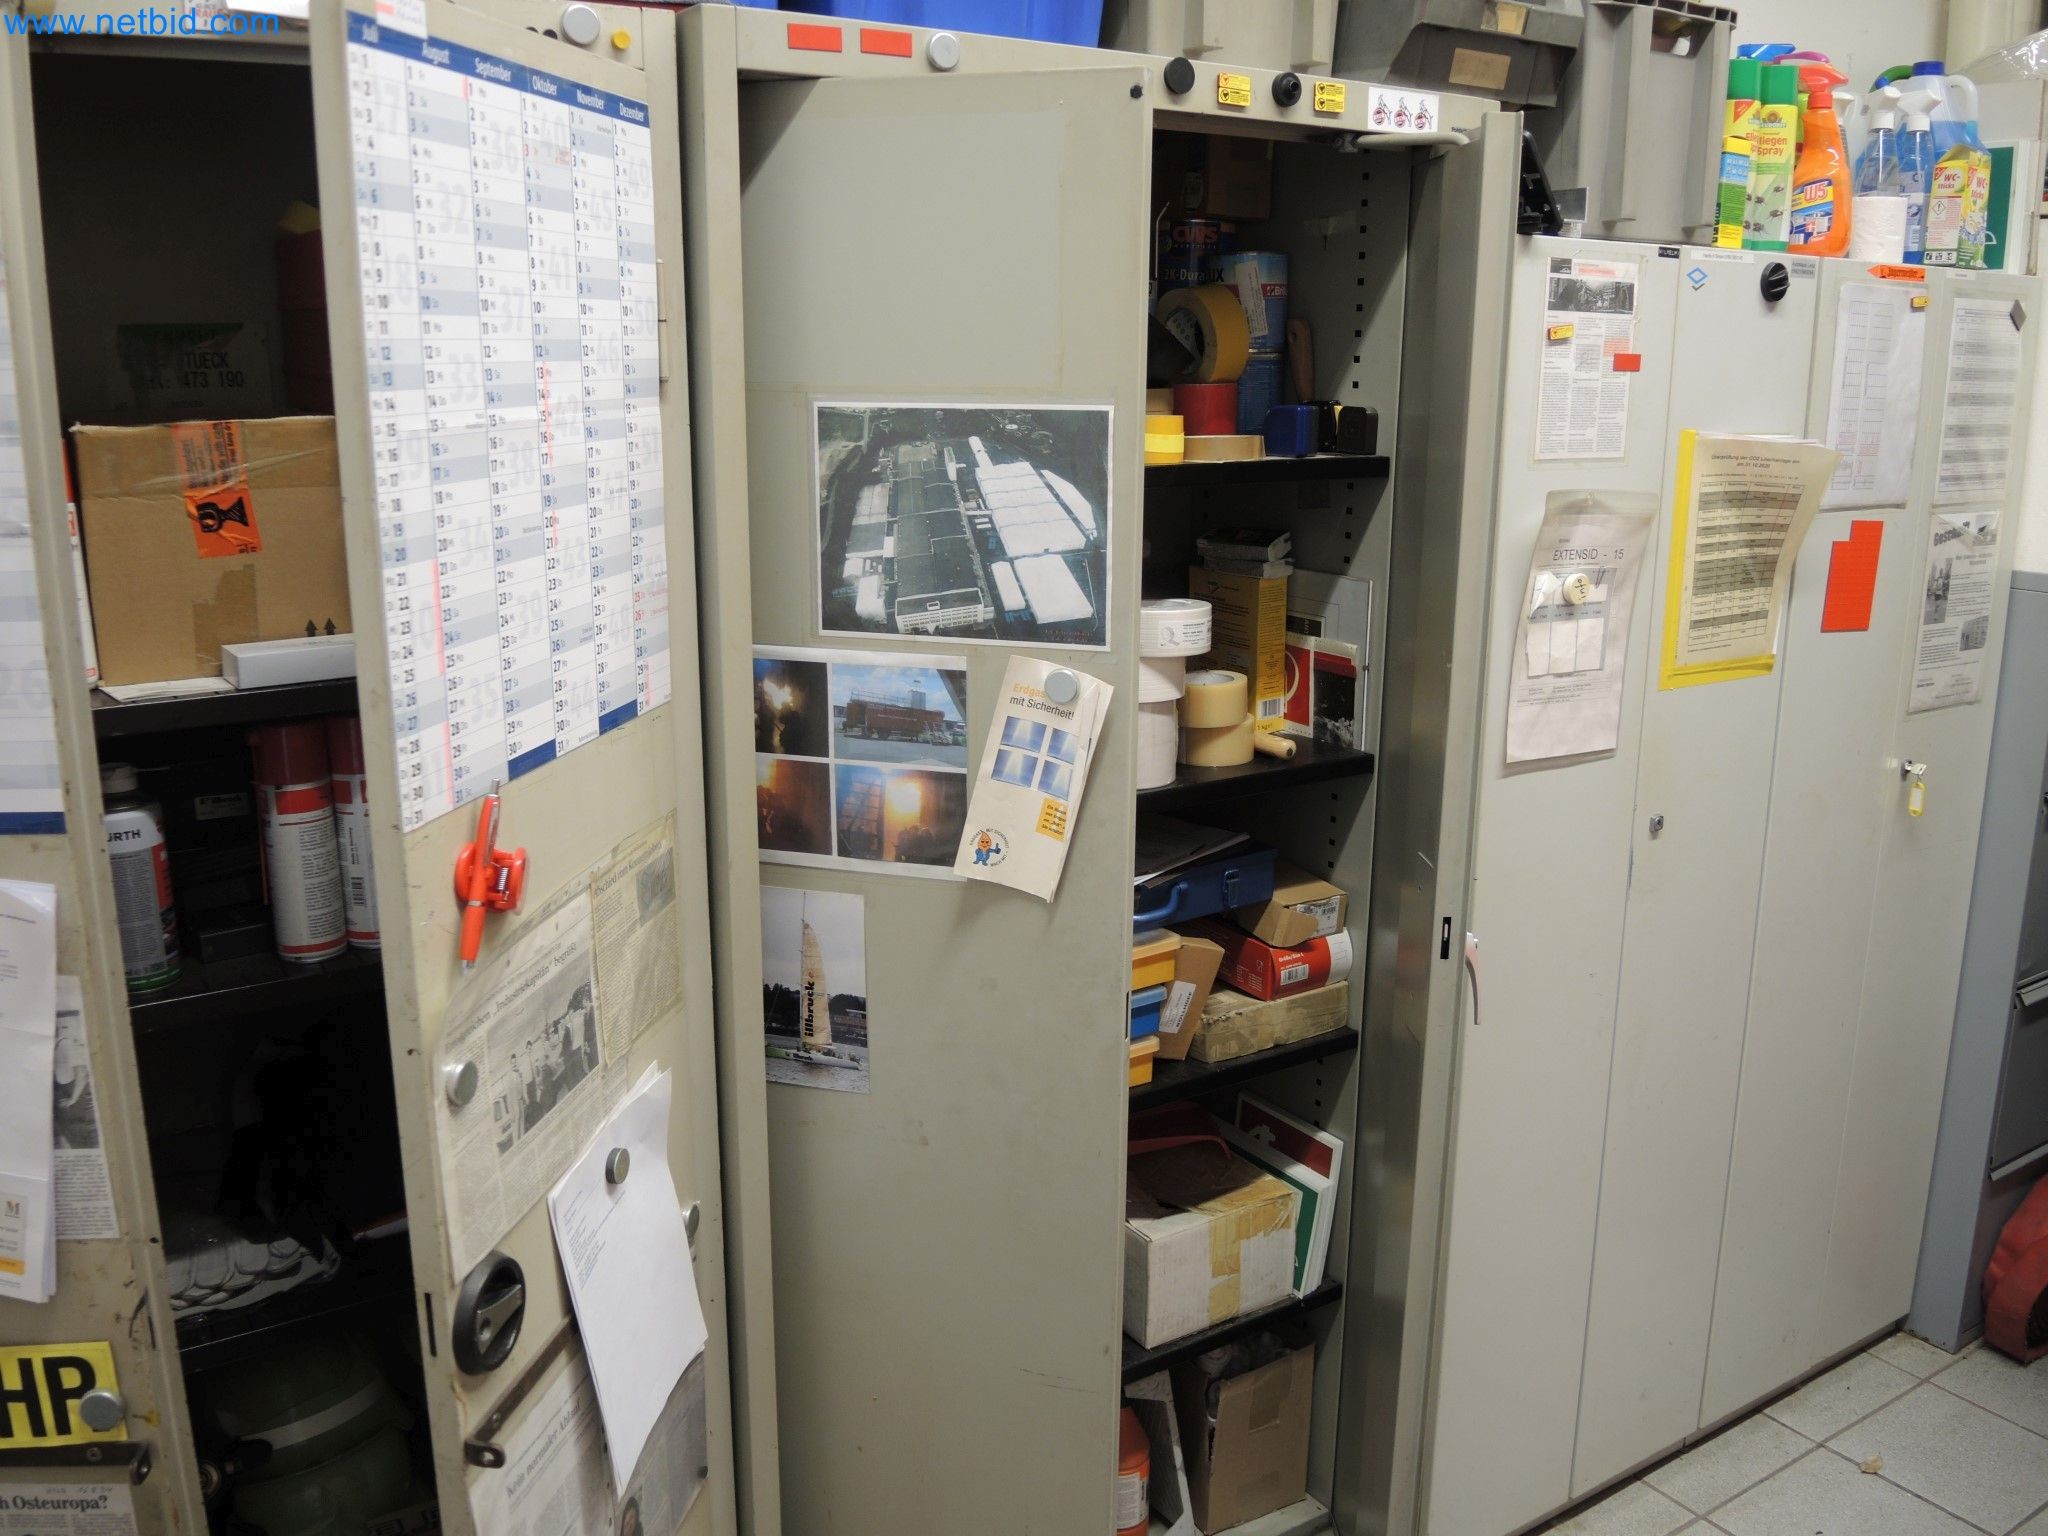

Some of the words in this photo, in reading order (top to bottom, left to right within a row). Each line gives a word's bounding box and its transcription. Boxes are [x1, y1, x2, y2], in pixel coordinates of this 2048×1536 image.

[422, 42, 450, 65] August
[475, 57, 512, 83] September
[532, 75, 558, 97] Oktober
[576, 88, 605, 111] November
[619, 102, 645, 123] Dezember
[1944, 173, 1961, 182] WC-
[480, 298, 489, 311] 10
[533, 301, 541, 313] 10
[481, 322, 490, 334] 11
[533, 323, 542, 335] 11
[483, 345, 492, 358] 12
[534, 345, 543, 357] 12
[484, 368, 493, 381] 13
[536, 366, 545, 378] 13
[218, 370, 245, 388] 190
[486, 391, 495, 404] 14
[537, 388, 546, 400] 14
[488, 414, 497, 427] 15
[538, 410, 546, 422] 15
[489, 436, 498, 449] 16
[540, 431, 548, 443] 16
[540, 452, 549, 464] 17
[490, 459, 499, 472] 17
[542, 474, 551, 486] 18
[491, 481, 500, 494] 18
[543, 495, 552, 507] 19
[493, 504, 502, 517] 19
[544, 516, 553, 528] 20
[494, 526, 504, 539] 20
[545, 537, 554, 549] 21
[495, 548, 504, 561] 21
[1552, 548, 1599, 561] EXTENSID
[1613, 549, 1625, 560] 15
[547, 558, 556, 570] 22
[497, 570, 506, 583] 22
[548, 578, 557, 590] 23
[498, 592, 507, 605] 23
[549, 599, 558, 611] 24
[500, 614, 509, 627] 24
[550, 619, 559, 631] 25
[501, 636, 510, 648] 25
[552, 640, 560, 652] 26
[502, 657, 512, 670] 26
[552, 660, 561, 672] 27
[503, 678, 512, 691] 27
[554, 680, 563, 692] 28
[505, 700, 514, 712] 28
[555, 700, 564, 712] 29
[1009, 696, 1025, 707] mit
[1027, 698, 1075, 720] Sicherheit!
[506, 721, 516, 734] 29
[556, 719, 565, 731] 30
[508, 742, 517, 755] 30
[557, 740, 566, 752] 31
[804, 981, 815, 1037] illbruck
[12, 1495, 109, 1512] Osteuropa?
